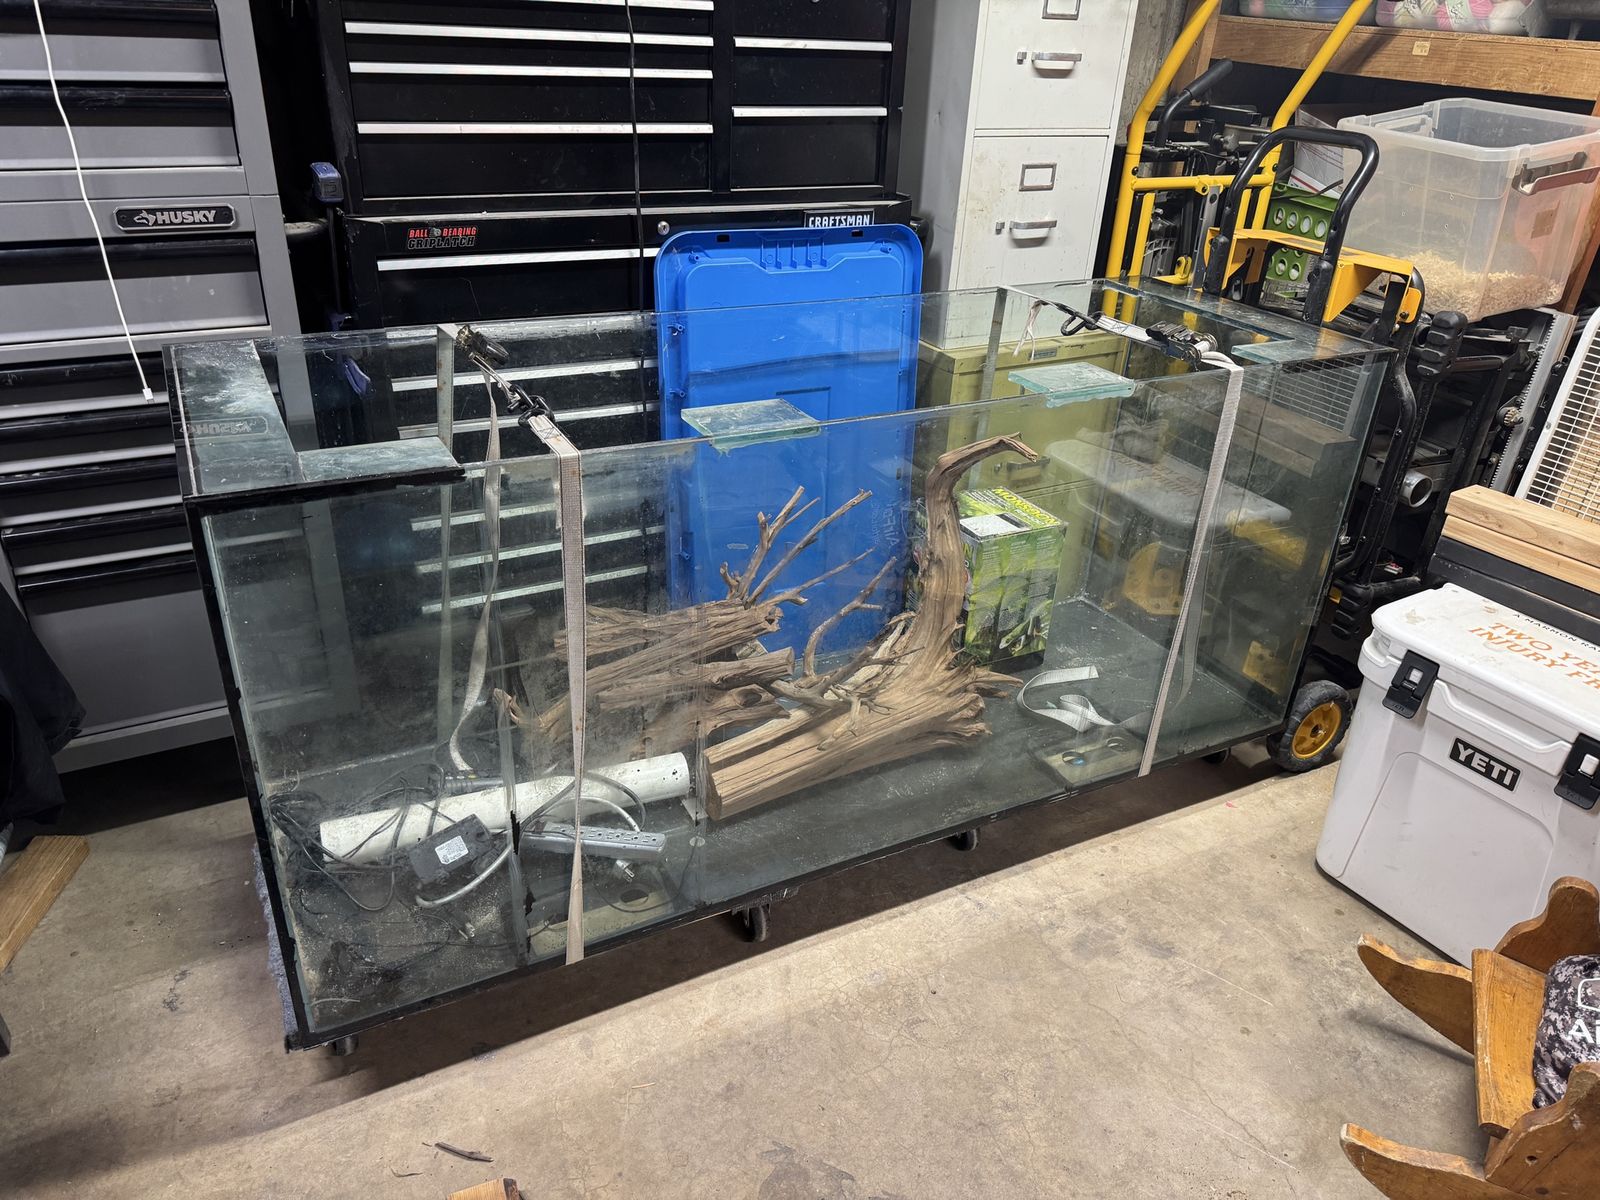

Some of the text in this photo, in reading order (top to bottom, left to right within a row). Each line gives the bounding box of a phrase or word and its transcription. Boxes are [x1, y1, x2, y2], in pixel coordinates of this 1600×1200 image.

[156, 210, 216, 224] HUSKY
[808, 214, 871, 228] CRAFTSMAN
[408, 236, 475, 249] GRIPLATCH
[409, 226, 477, 238] BALL BEARING
[992, 488, 1058, 525] MONSOON
[1488, 622, 1553, 651] TWO
[1525, 618, 1577, 642] MARMON
[1467, 627, 1568, 668] INJURY
[1457, 742, 1514, 786] YETI
